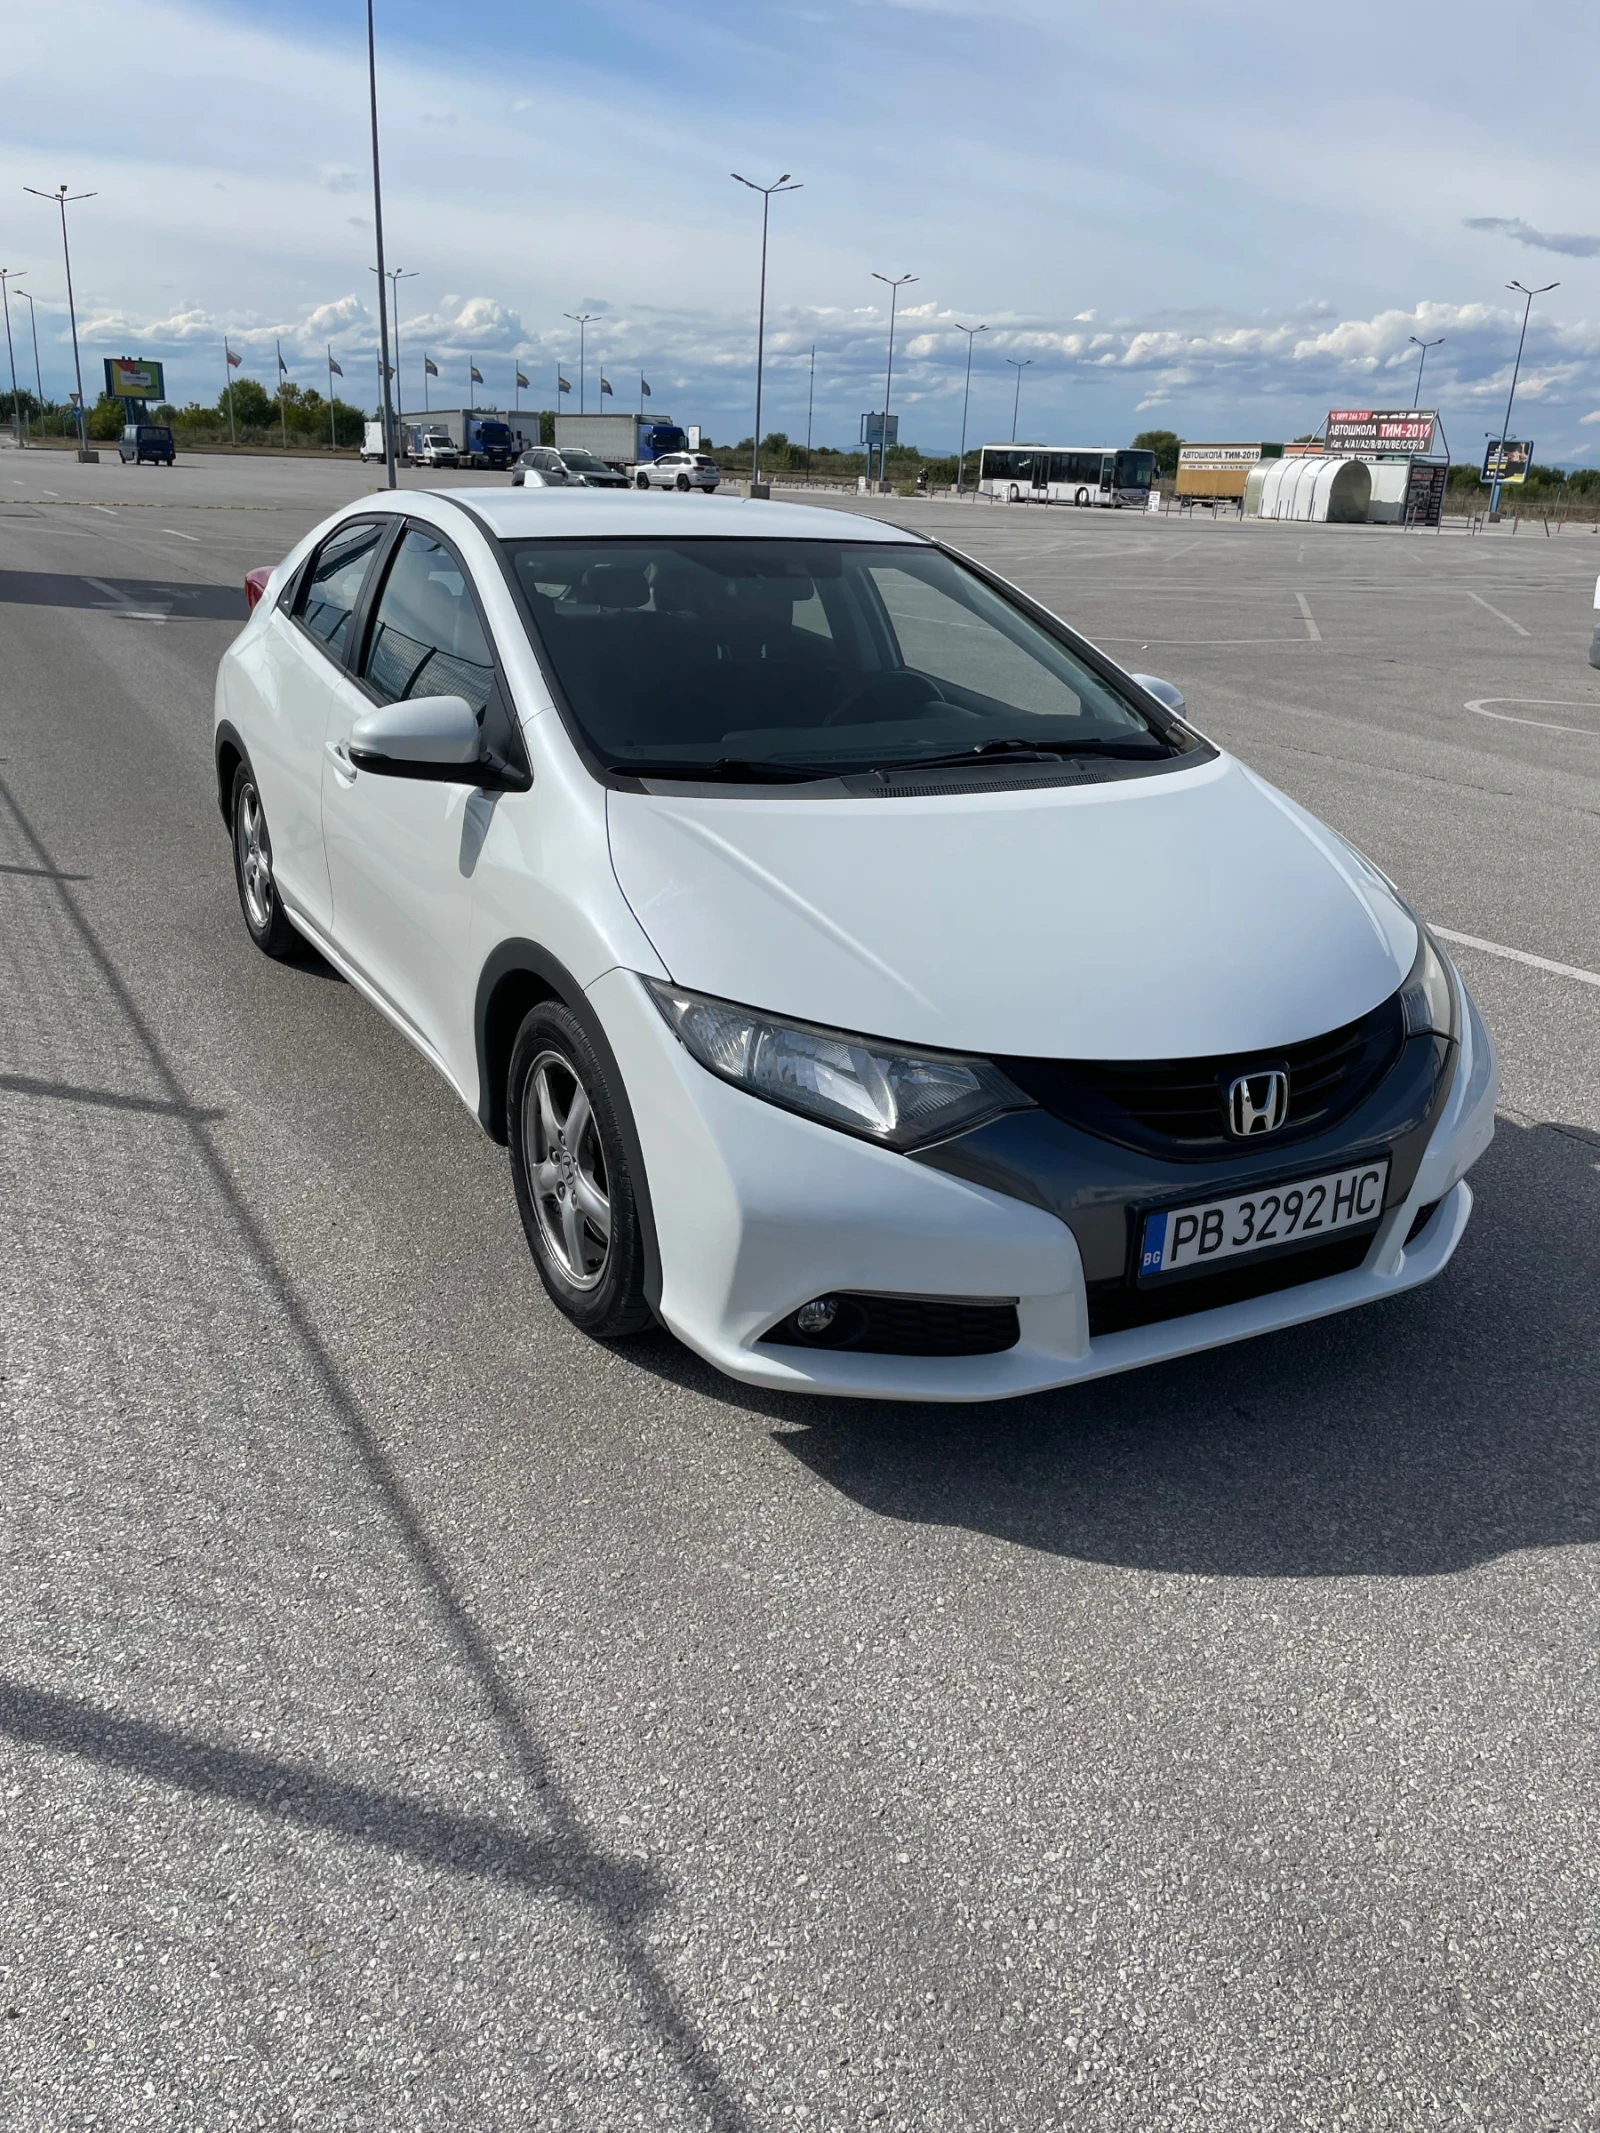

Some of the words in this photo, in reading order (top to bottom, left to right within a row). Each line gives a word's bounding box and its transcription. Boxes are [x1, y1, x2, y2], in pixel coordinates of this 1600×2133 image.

[1336, 412, 1348, 420] 0899
[1329, 424, 1377, 436] АВТОШКОЛА
[1380, 423, 1431, 437] ТИМ-2019
[1182, 451, 1222, 459] АВТОШКОЛА
[1224, 451, 1260, 459] ТИМ-2019
[1170, 1208, 1224, 1262] PB
[1232, 1184, 1327, 1246] 3292
[1331, 1170, 1380, 1224] HC
[1143, 1251, 1161, 1267] BG
